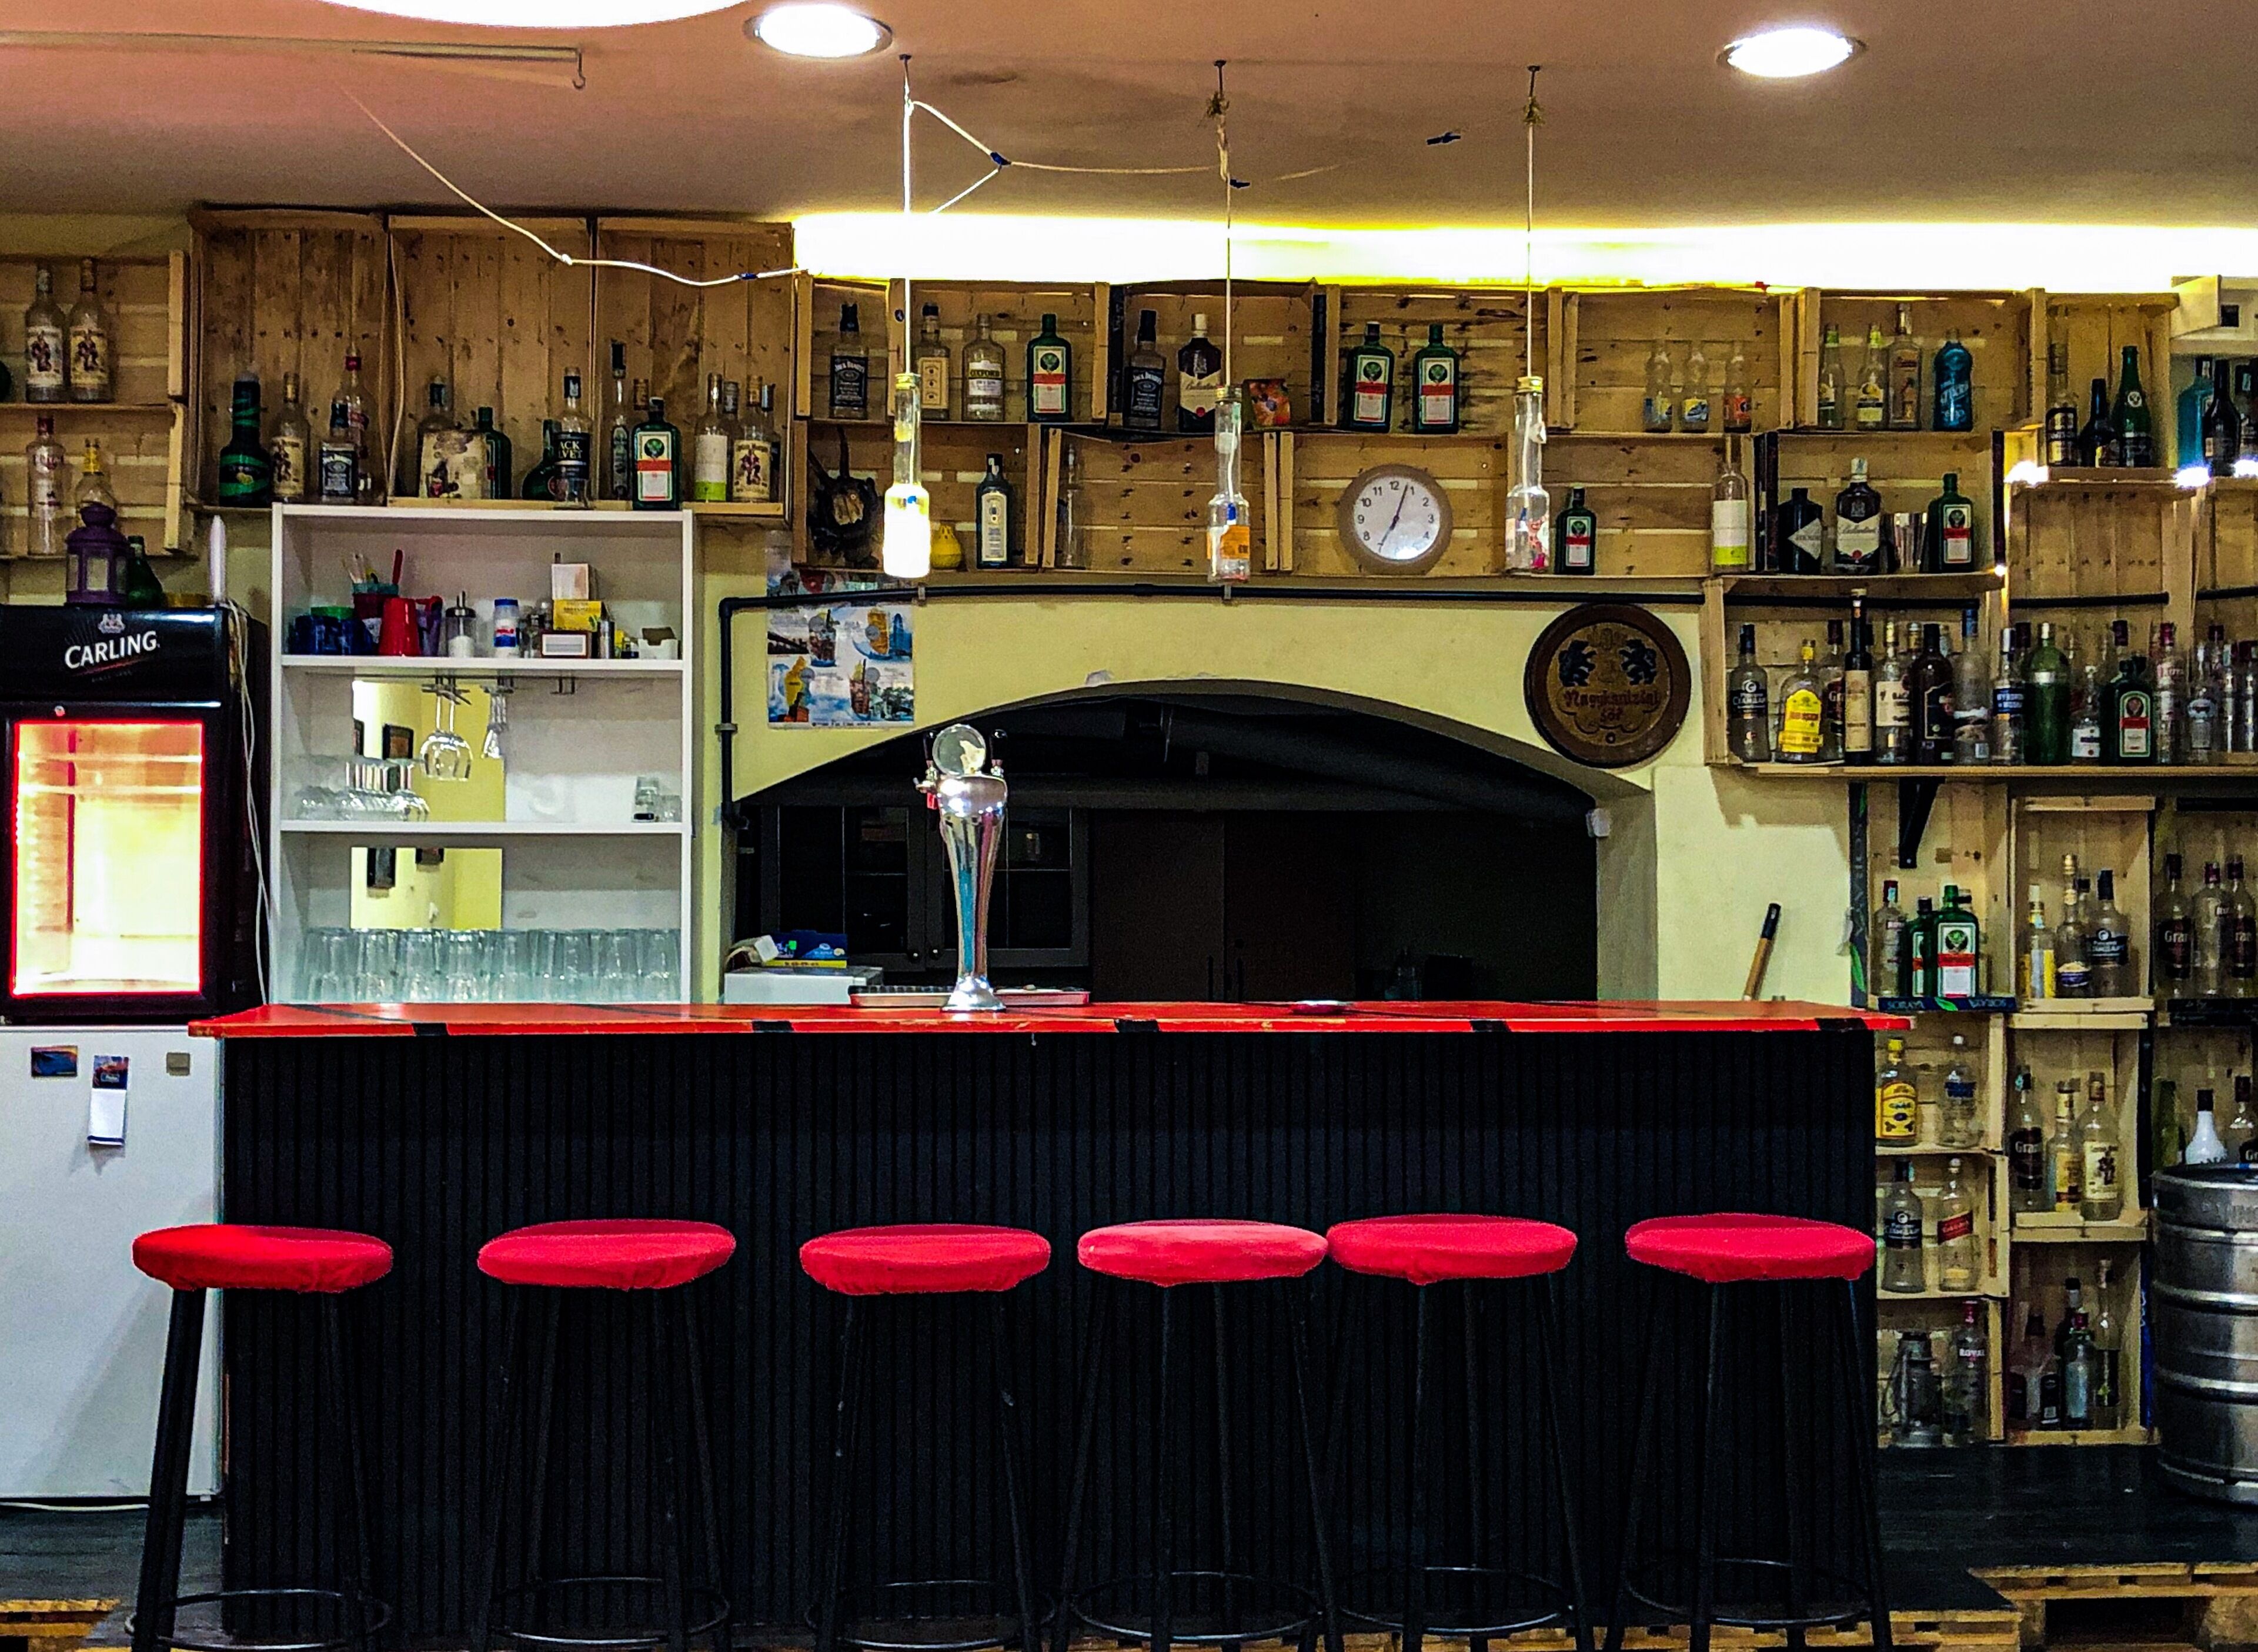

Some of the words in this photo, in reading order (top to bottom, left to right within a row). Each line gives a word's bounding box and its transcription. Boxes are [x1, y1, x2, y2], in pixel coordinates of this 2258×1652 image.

[1388, 480, 1399, 490] 12
[1372, 486, 1382, 496] 11
[1409, 486, 1415, 495] 1
[1360, 497, 1371, 507] 10
[1422, 497, 1429, 507] 2
[1357, 514, 1365, 524] 9
[1428, 514, 1435, 524] 3
[1362, 531, 1370, 541] 8
[1422, 531, 1429, 540] 4
[64, 630, 158, 669] CARLING
